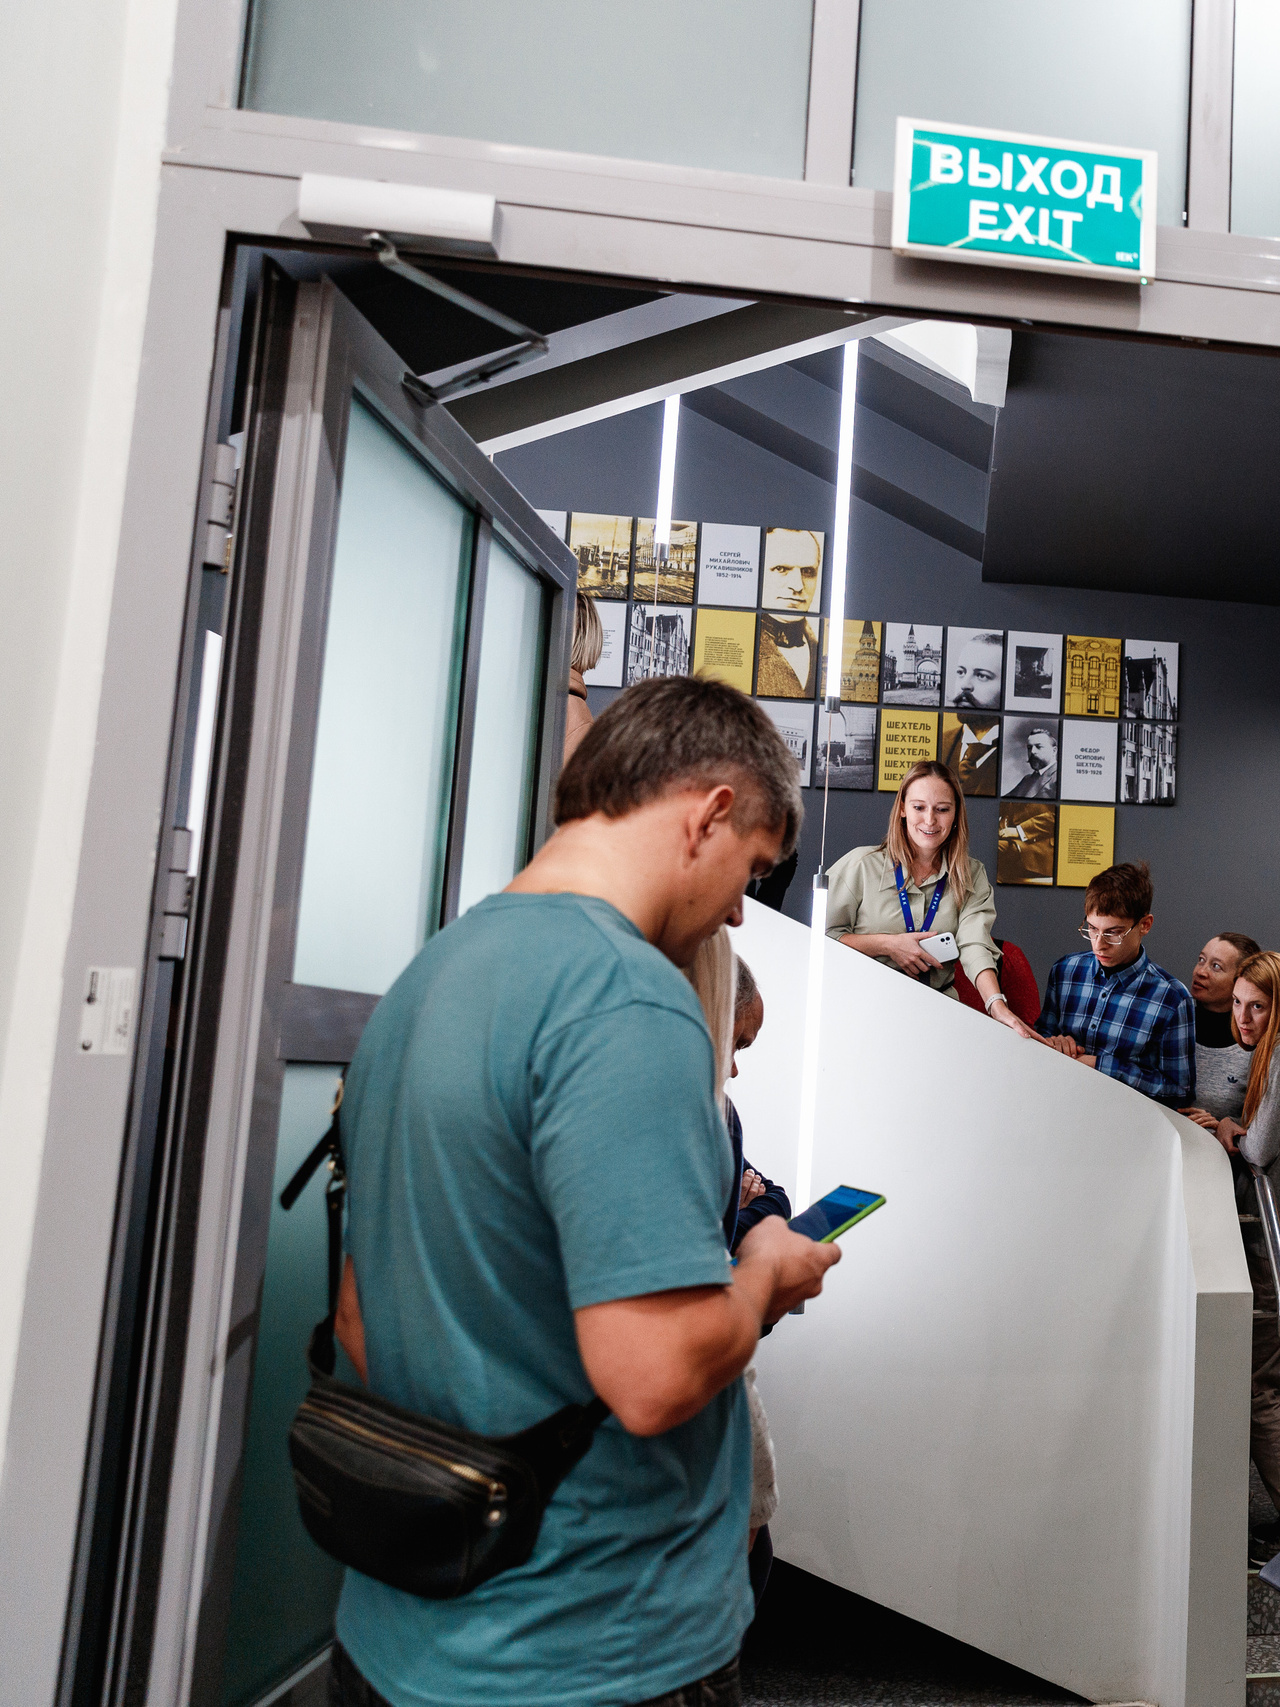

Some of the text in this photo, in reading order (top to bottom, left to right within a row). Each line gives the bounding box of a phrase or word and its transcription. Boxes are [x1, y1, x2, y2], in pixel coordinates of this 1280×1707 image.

[929, 144, 1124, 213] ВЫХОД
[969, 199, 1083, 249] EXIT
[709, 557, 751, 566] МИХАЙЛОВИЧ
[705, 564, 753, 573] РУКАВИШНИКОВ
[886, 720, 931, 731] ШЕХТЕЛЬ
[886, 733, 931, 744] ШЕХТЕЛЬ
[885, 746, 930, 757] ШЕХТЕЛЬ
